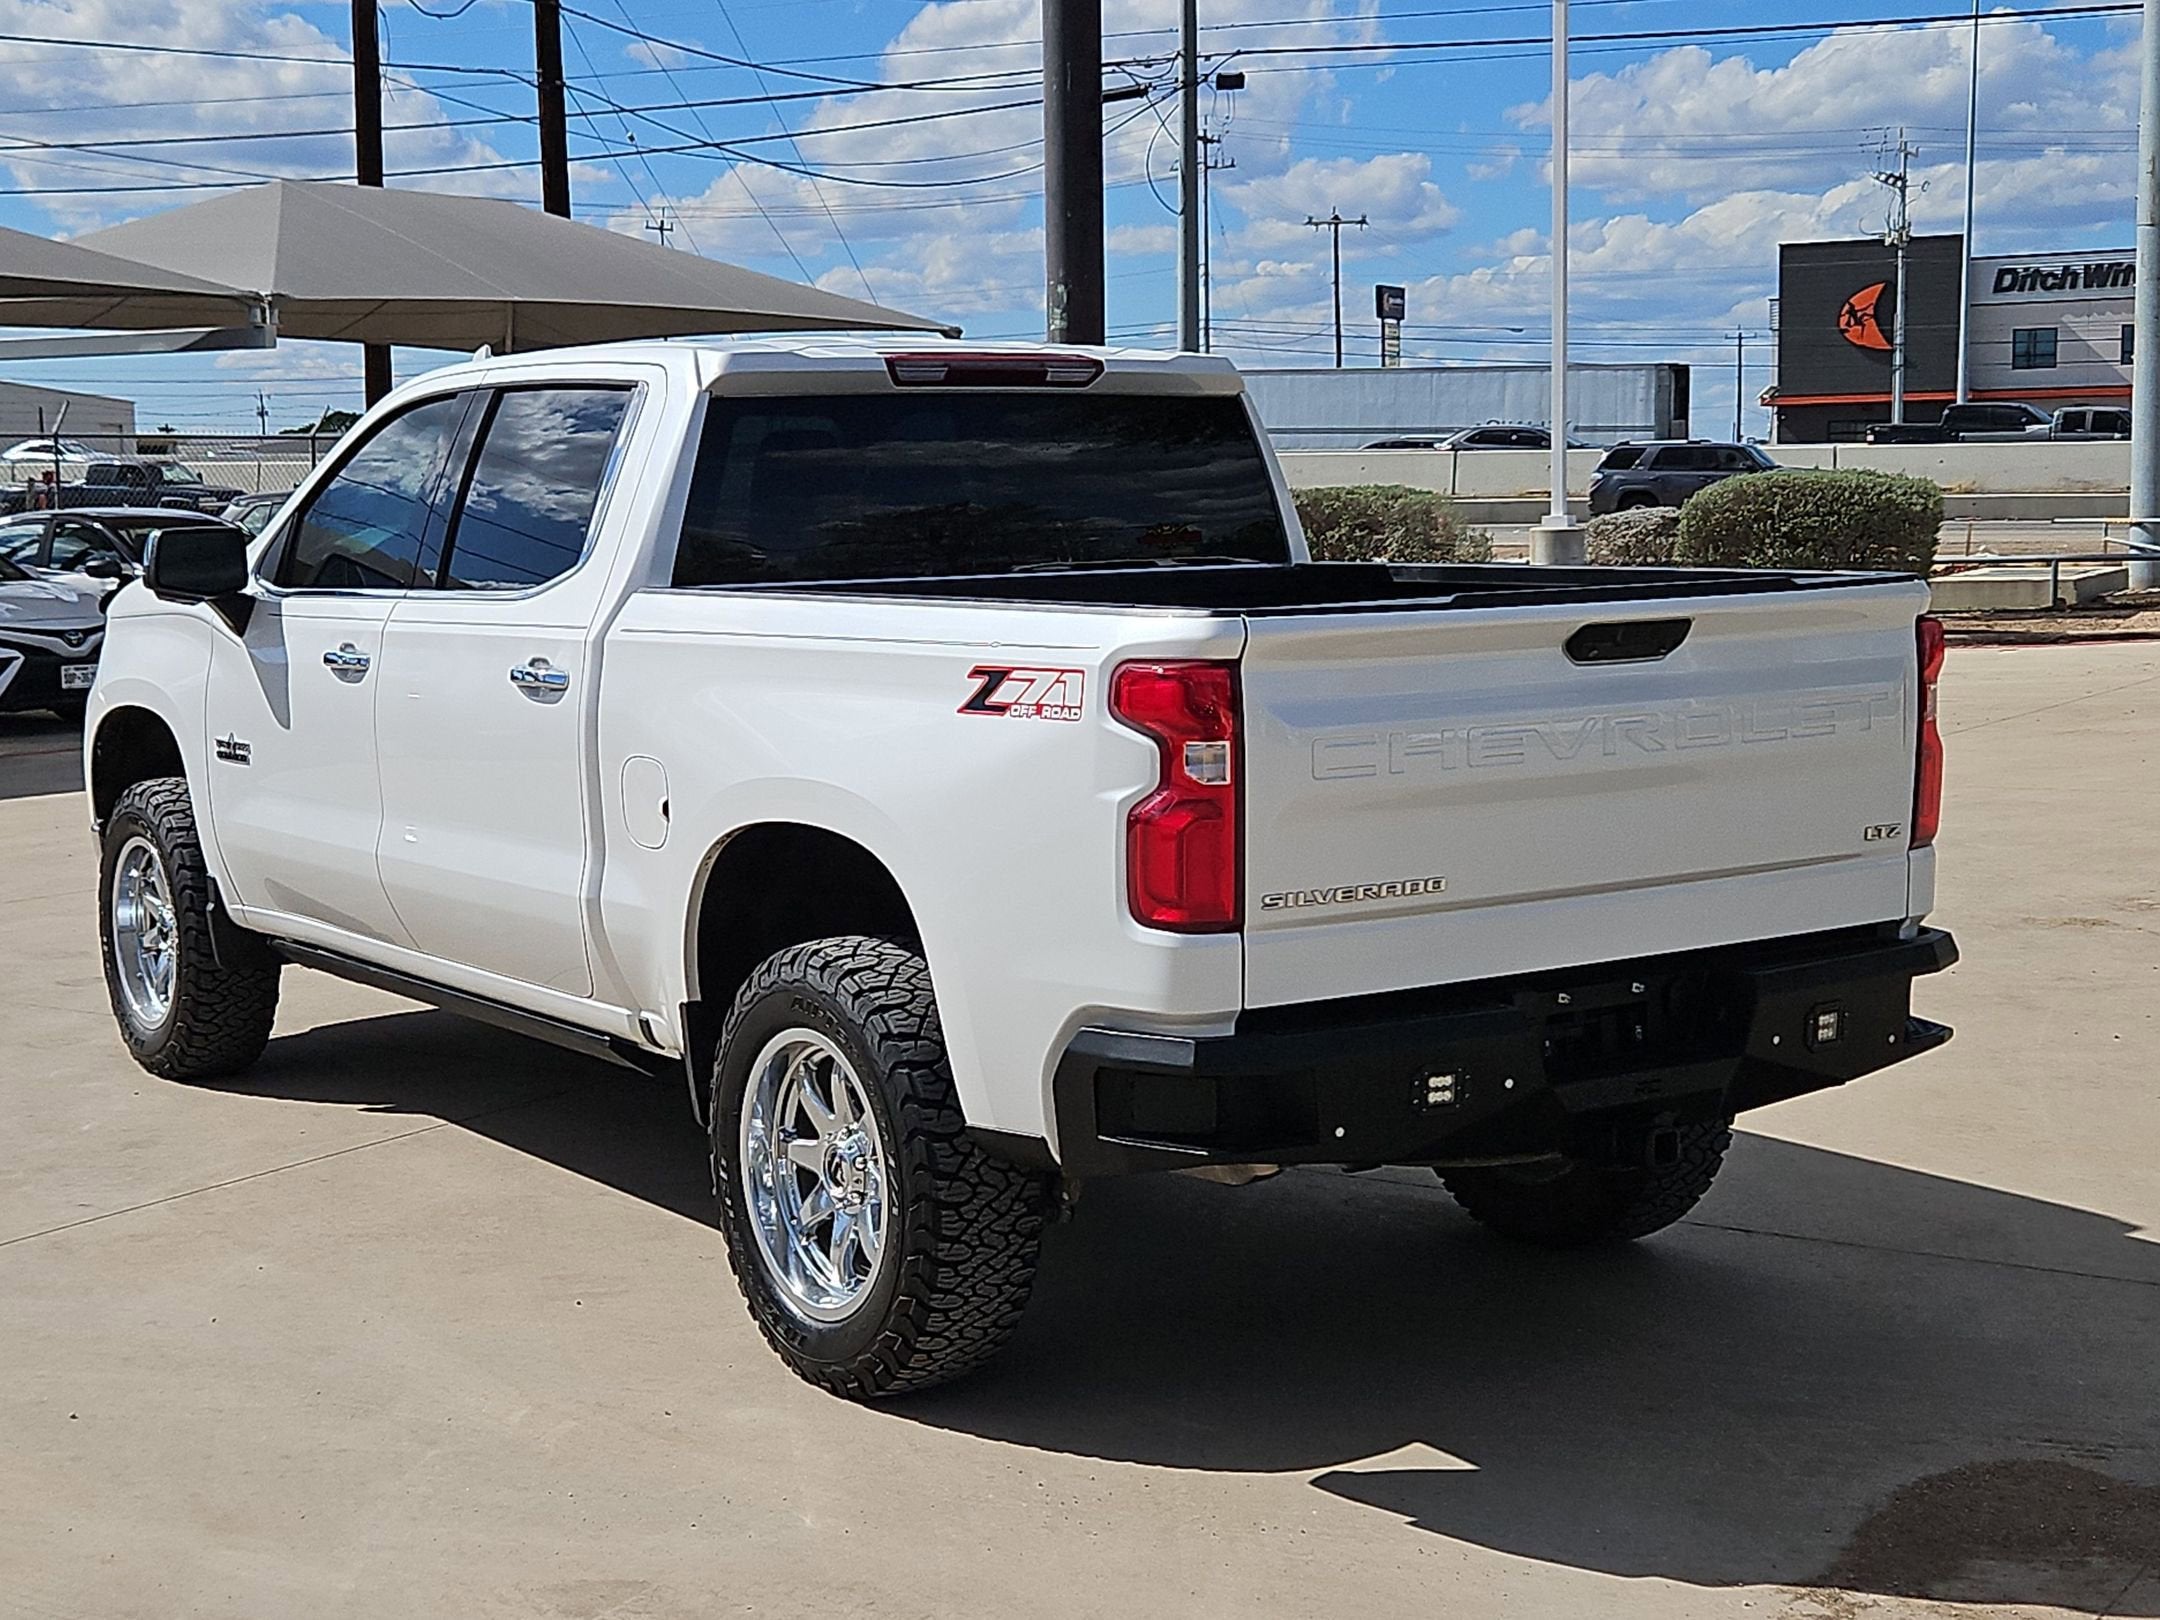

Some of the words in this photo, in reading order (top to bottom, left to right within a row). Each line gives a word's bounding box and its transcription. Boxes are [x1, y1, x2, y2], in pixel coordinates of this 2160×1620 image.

[1992, 265, 2080, 294] Ditch
[957, 665, 1085, 717] Z71
[1009, 703, 1038, 718] OFF
[1039, 704, 1082, 721] ROAD
[1312, 691, 1888, 781] CHEVROLET
[1864, 822, 1901, 841] LTZ
[1261, 876, 1447, 910] SILVERADO
